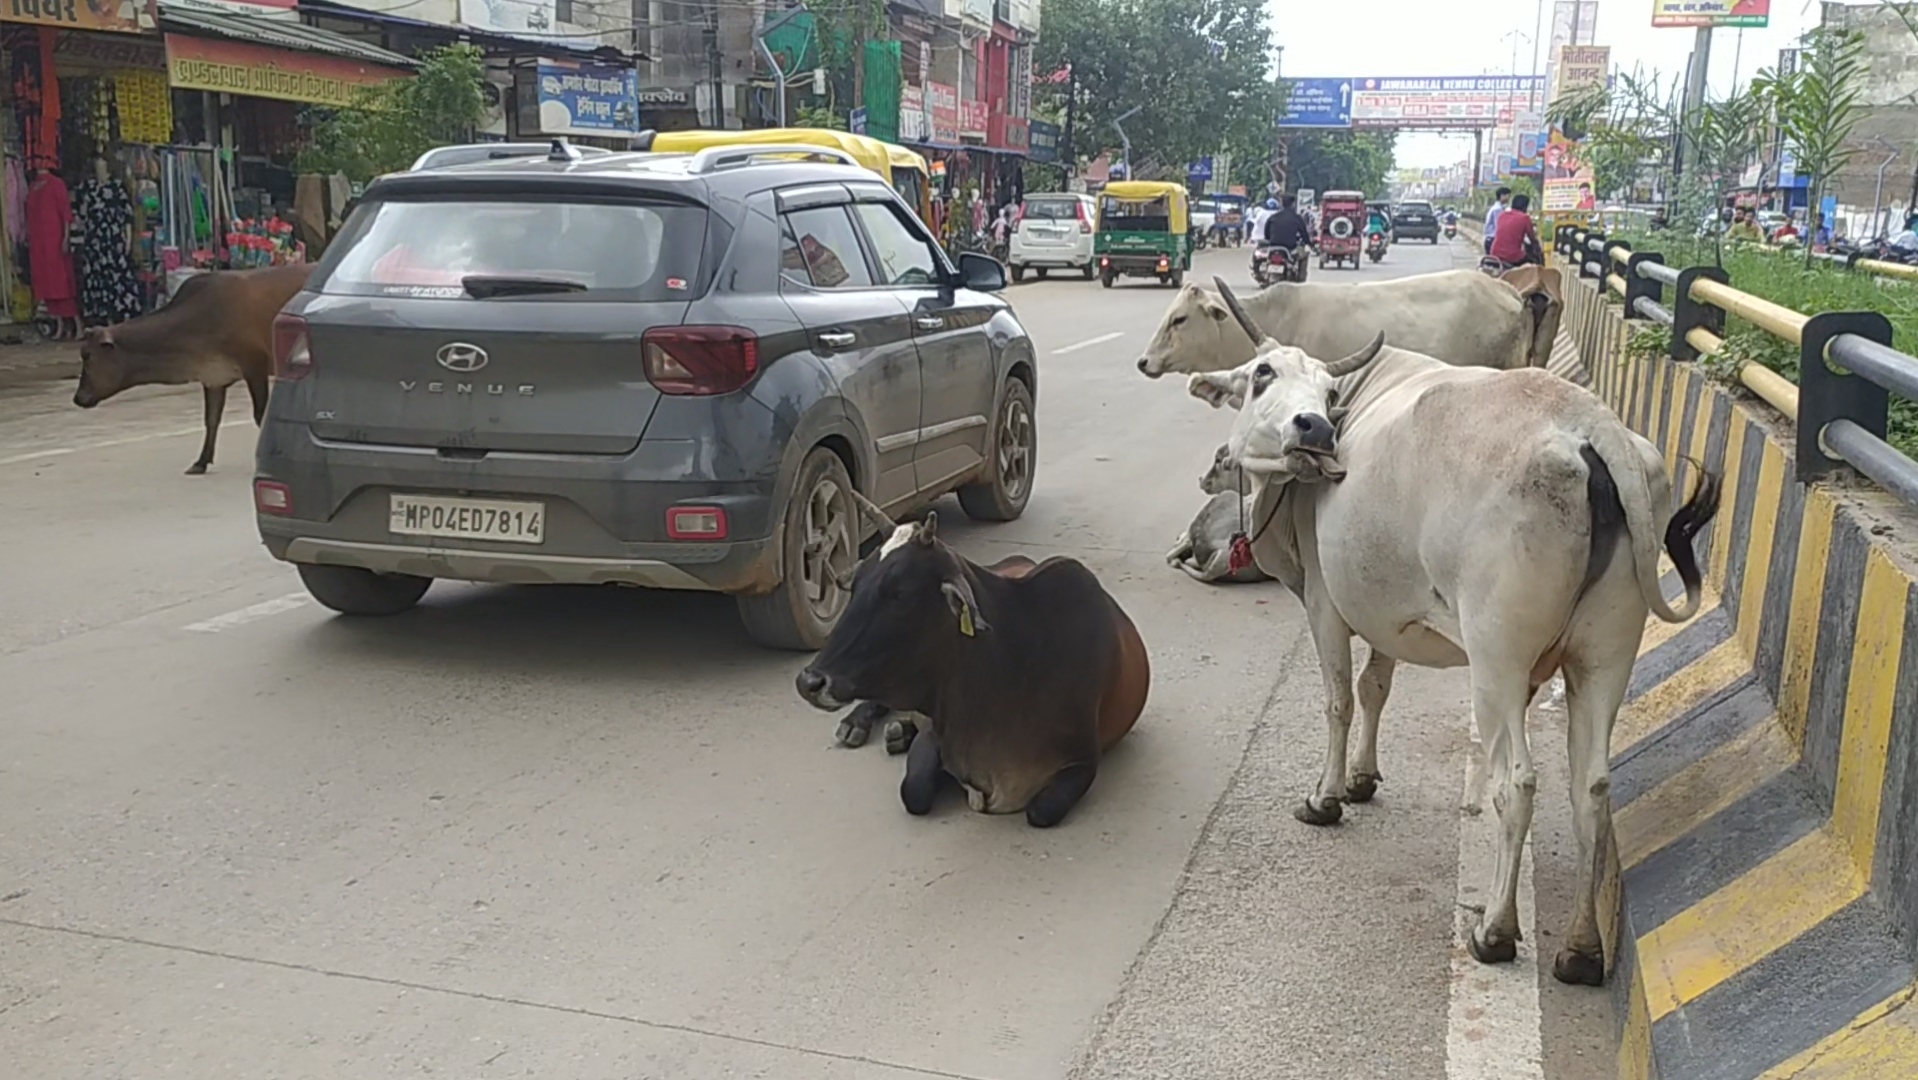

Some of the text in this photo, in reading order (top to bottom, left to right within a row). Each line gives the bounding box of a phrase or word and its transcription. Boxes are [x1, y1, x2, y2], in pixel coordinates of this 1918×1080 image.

[1562, 47, 1607, 64] मोतीलाल
[1381, 79, 1441, 90] JAWAHARLAL
[1442, 79, 1475, 90] NEHRU
[1477, 79, 1519, 90] COLLEGE
[1519, 79, 1532, 90] OF
[400, 380, 535, 396] VENUE
[316, 411, 336, 420] SX
[405, 504, 539, 537] MP04ED7814
